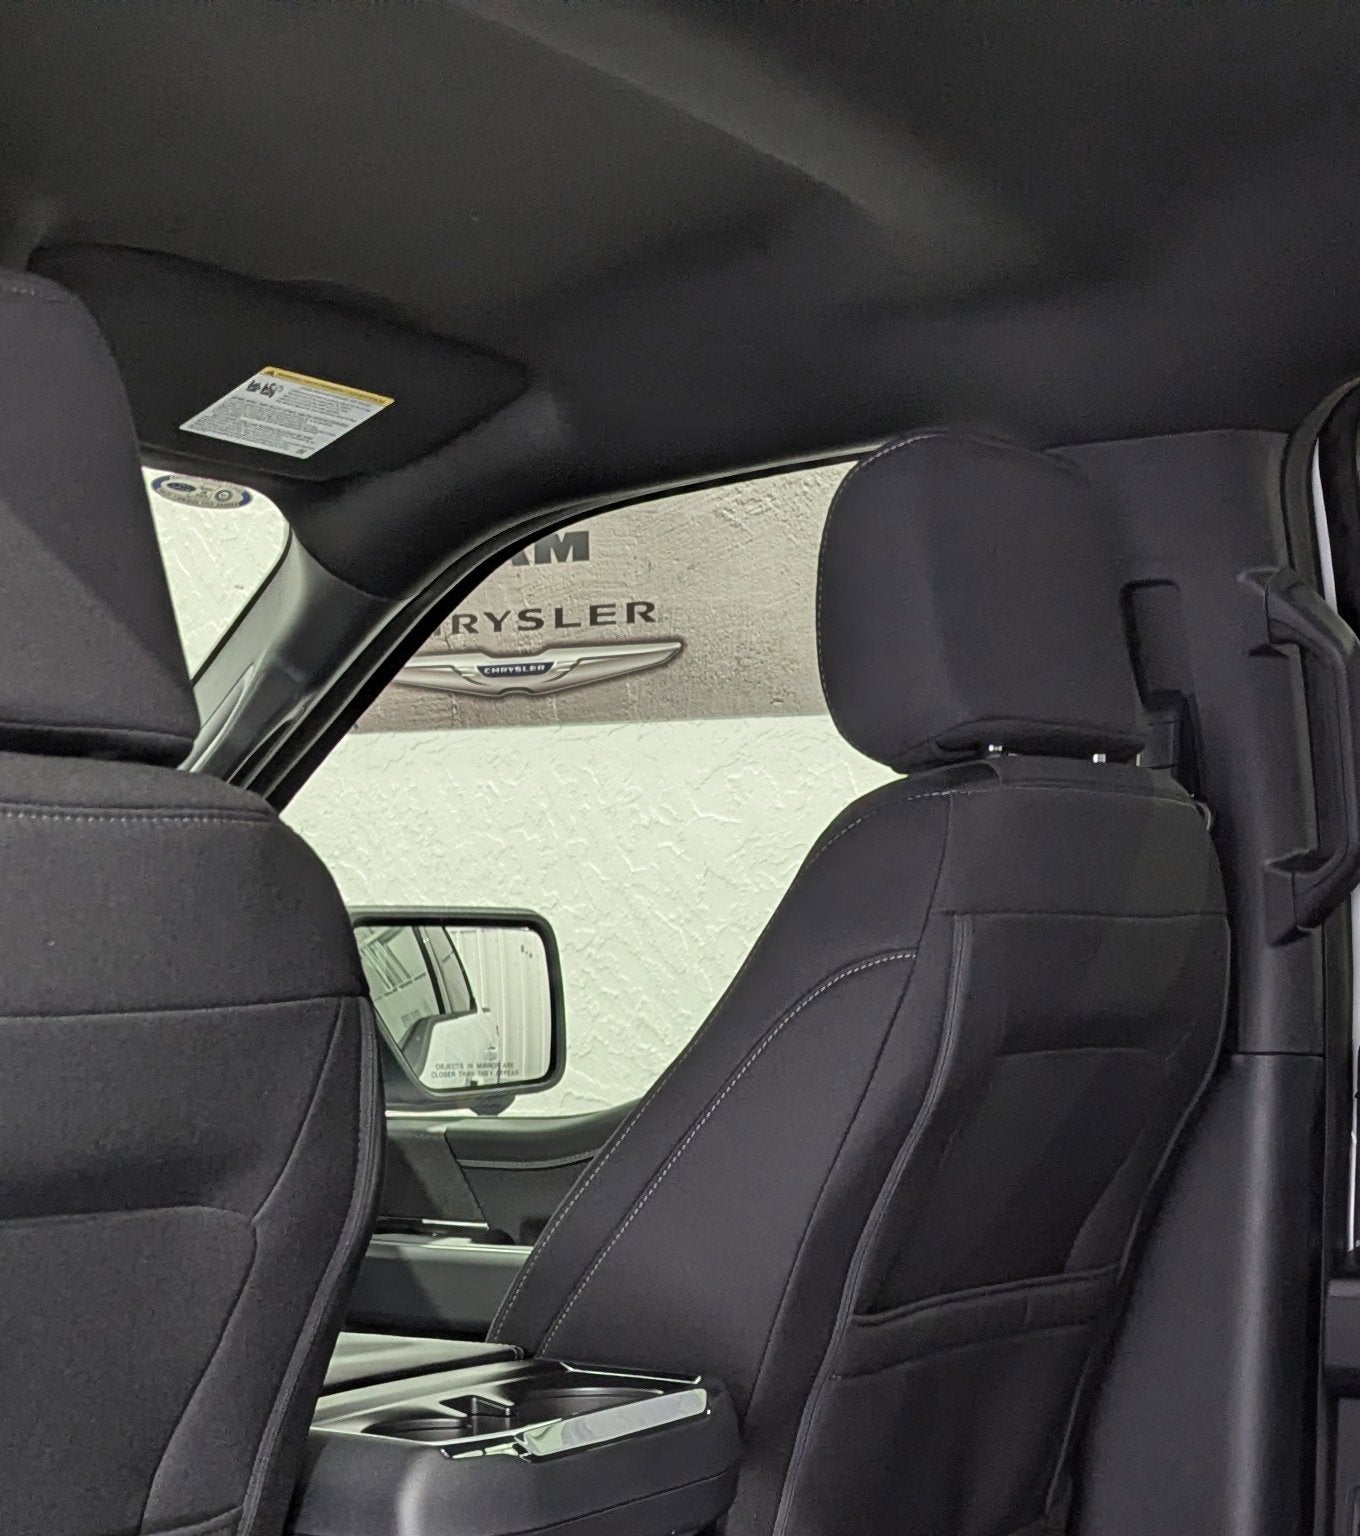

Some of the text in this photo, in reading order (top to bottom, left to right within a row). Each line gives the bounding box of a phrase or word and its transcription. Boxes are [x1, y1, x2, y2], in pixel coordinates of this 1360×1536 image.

[434, 601, 656, 636] RYSLER
[483, 664, 546, 675] CHRYSLER
[435, 1062, 464, 1070] OBJECTS
